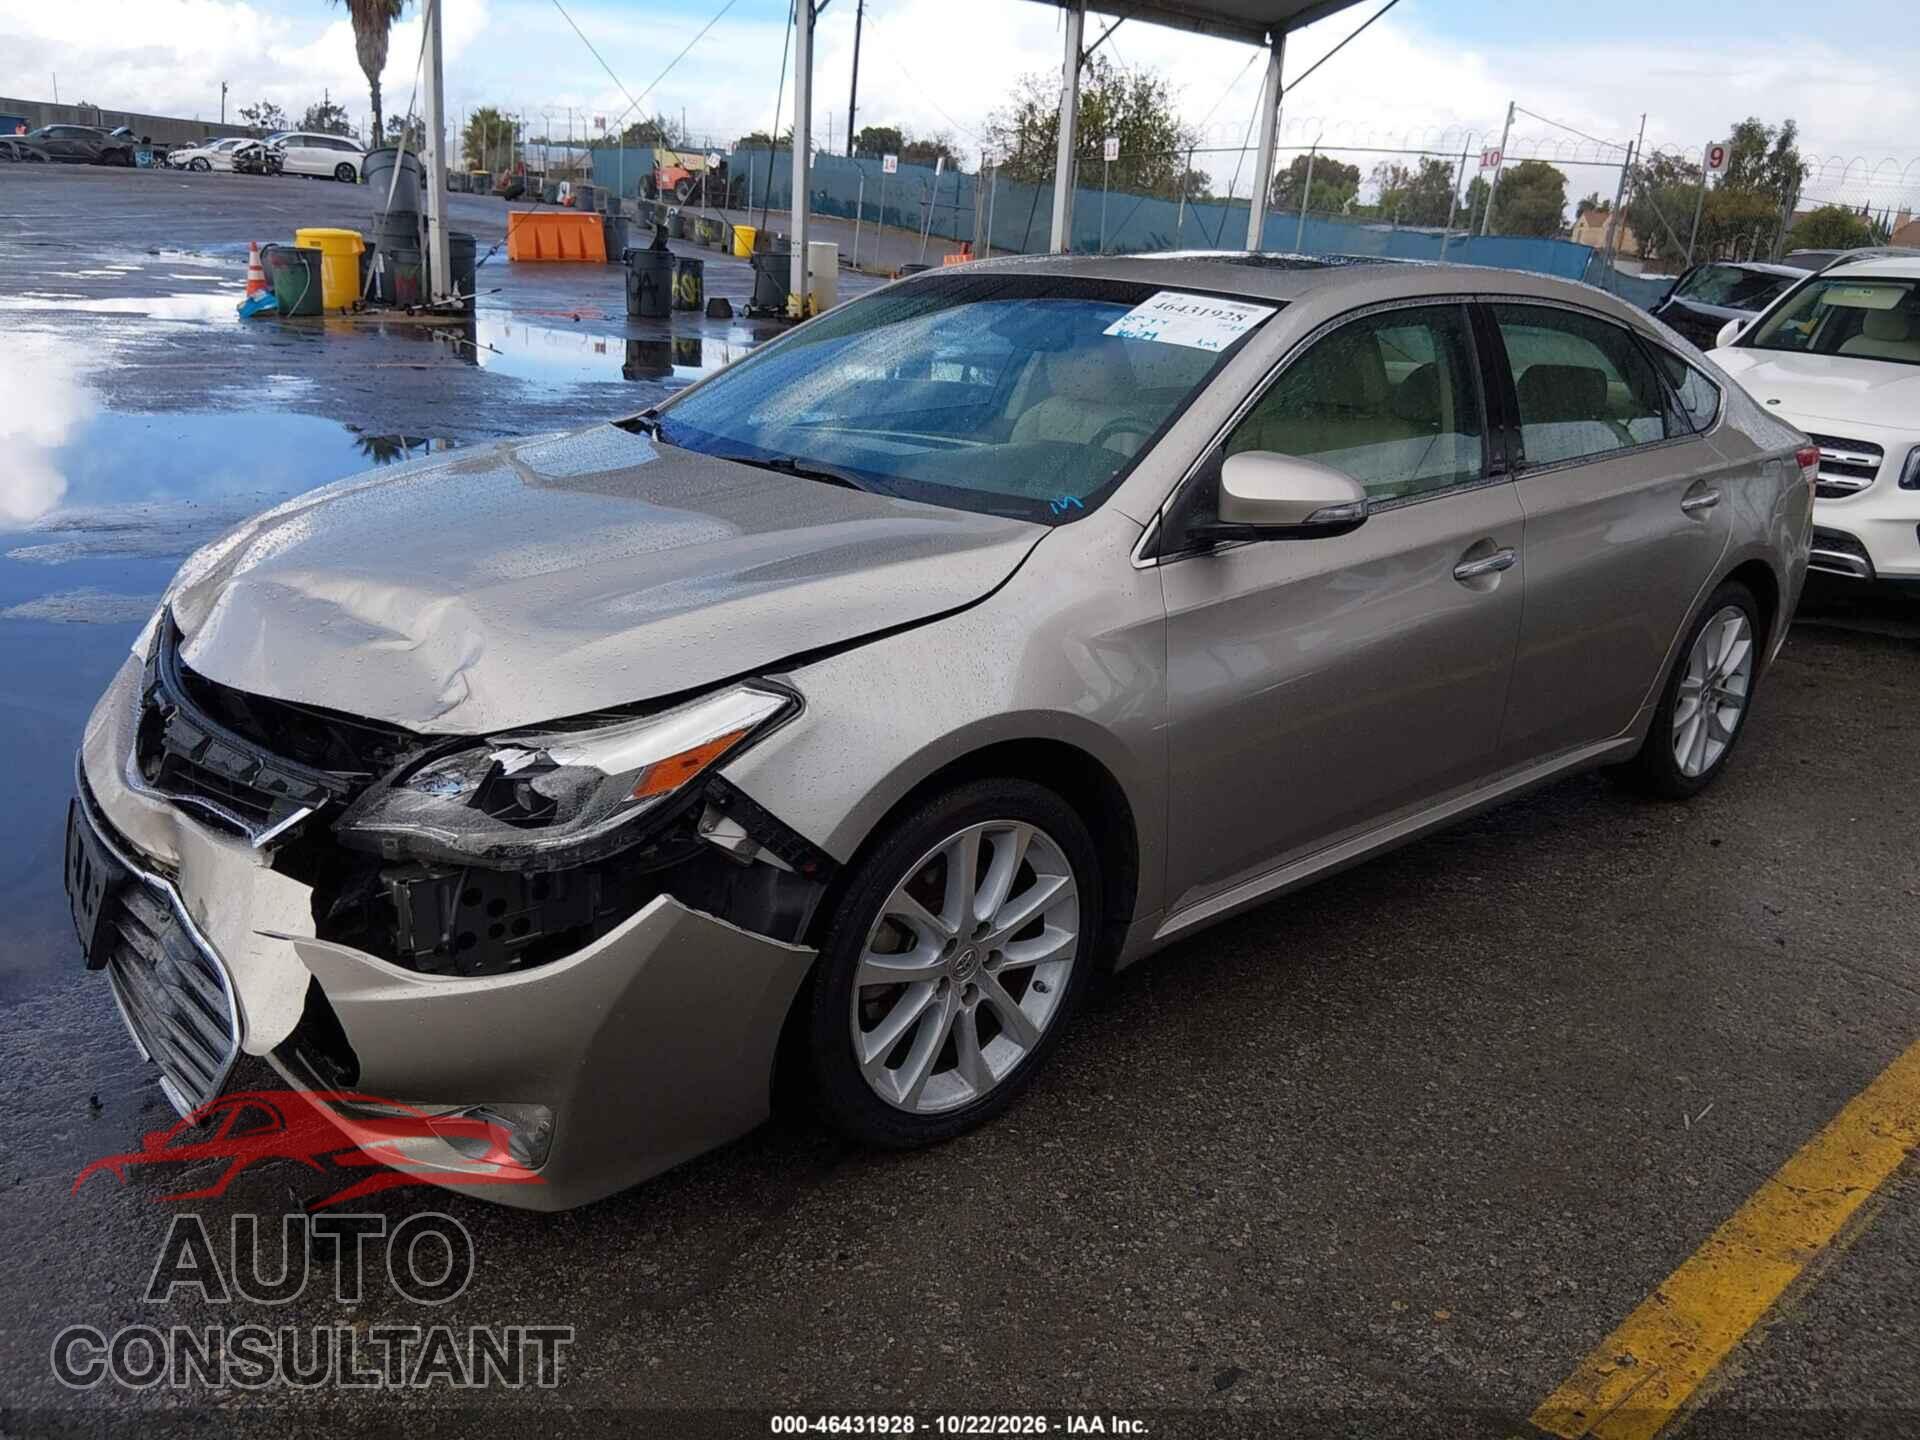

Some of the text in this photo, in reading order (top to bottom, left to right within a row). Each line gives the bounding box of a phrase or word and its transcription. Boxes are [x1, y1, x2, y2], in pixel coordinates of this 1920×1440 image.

[1480, 151, 1500, 168] 10
[1710, 147, 1724, 168] 9
[1153, 302, 1248, 322] 46431928
